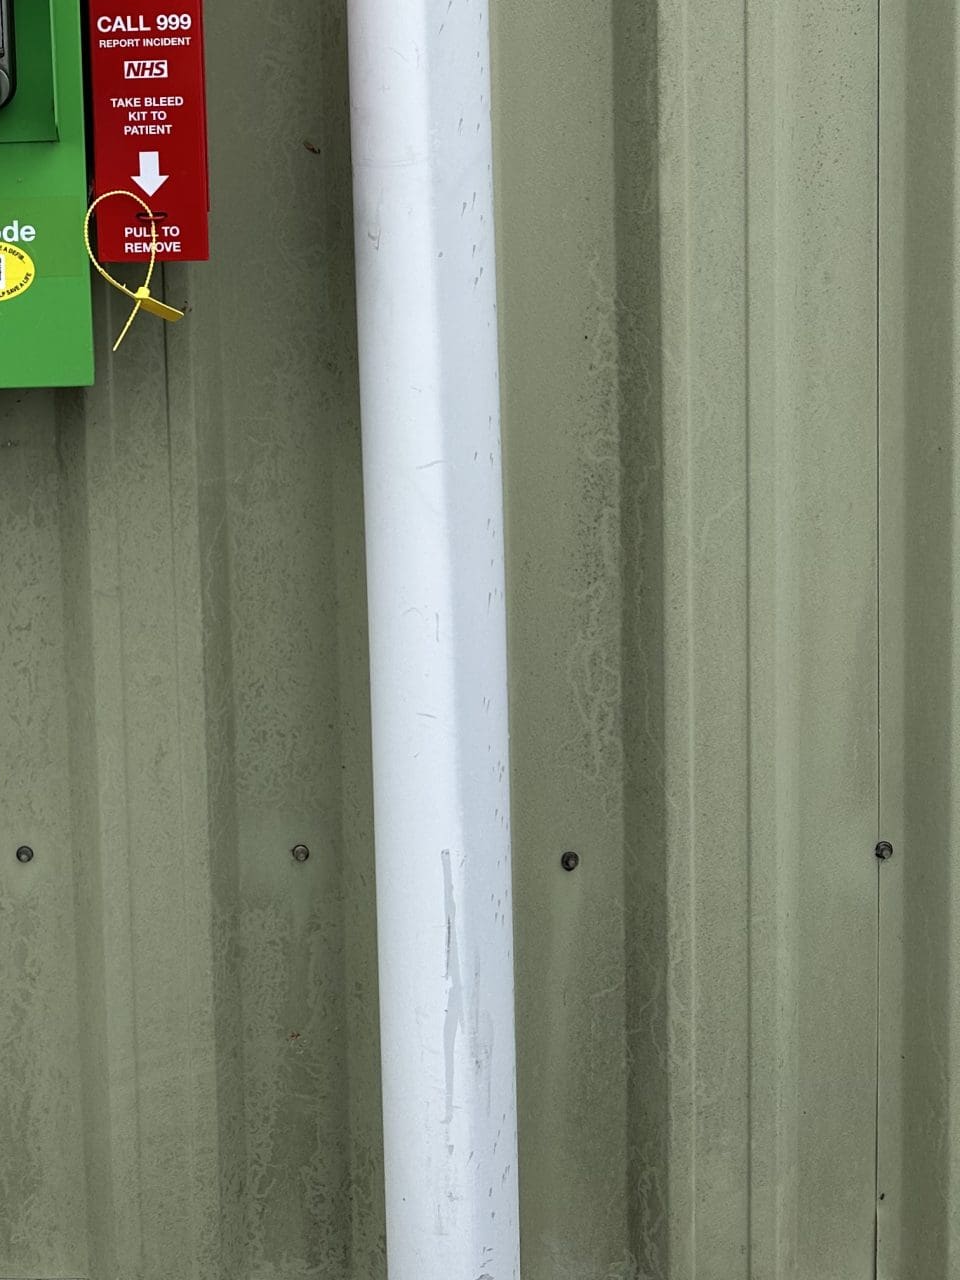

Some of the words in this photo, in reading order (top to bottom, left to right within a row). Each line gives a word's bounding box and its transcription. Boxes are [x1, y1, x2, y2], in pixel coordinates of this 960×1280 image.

[97, 15, 151, 33] CALL
[156, 14, 192, 31] 999
[99, 38, 140, 49] REPORT
[143, 37, 192, 47] INCIDENT
[125, 61, 167, 78] NHS
[110, 97, 142, 108] TAKE
[144, 96, 184, 107] BLEED
[128, 111, 147, 121] KIT
[150, 110, 167, 121] TO
[124, 124, 173, 136] PATIENT
[124, 226, 159, 238] PULL
[161, 225, 180, 237] TO
[124, 241, 182, 253] REMOVE
[6, 284, 20, 296] SAVE
[23, 272, 33, 284] LIFE
